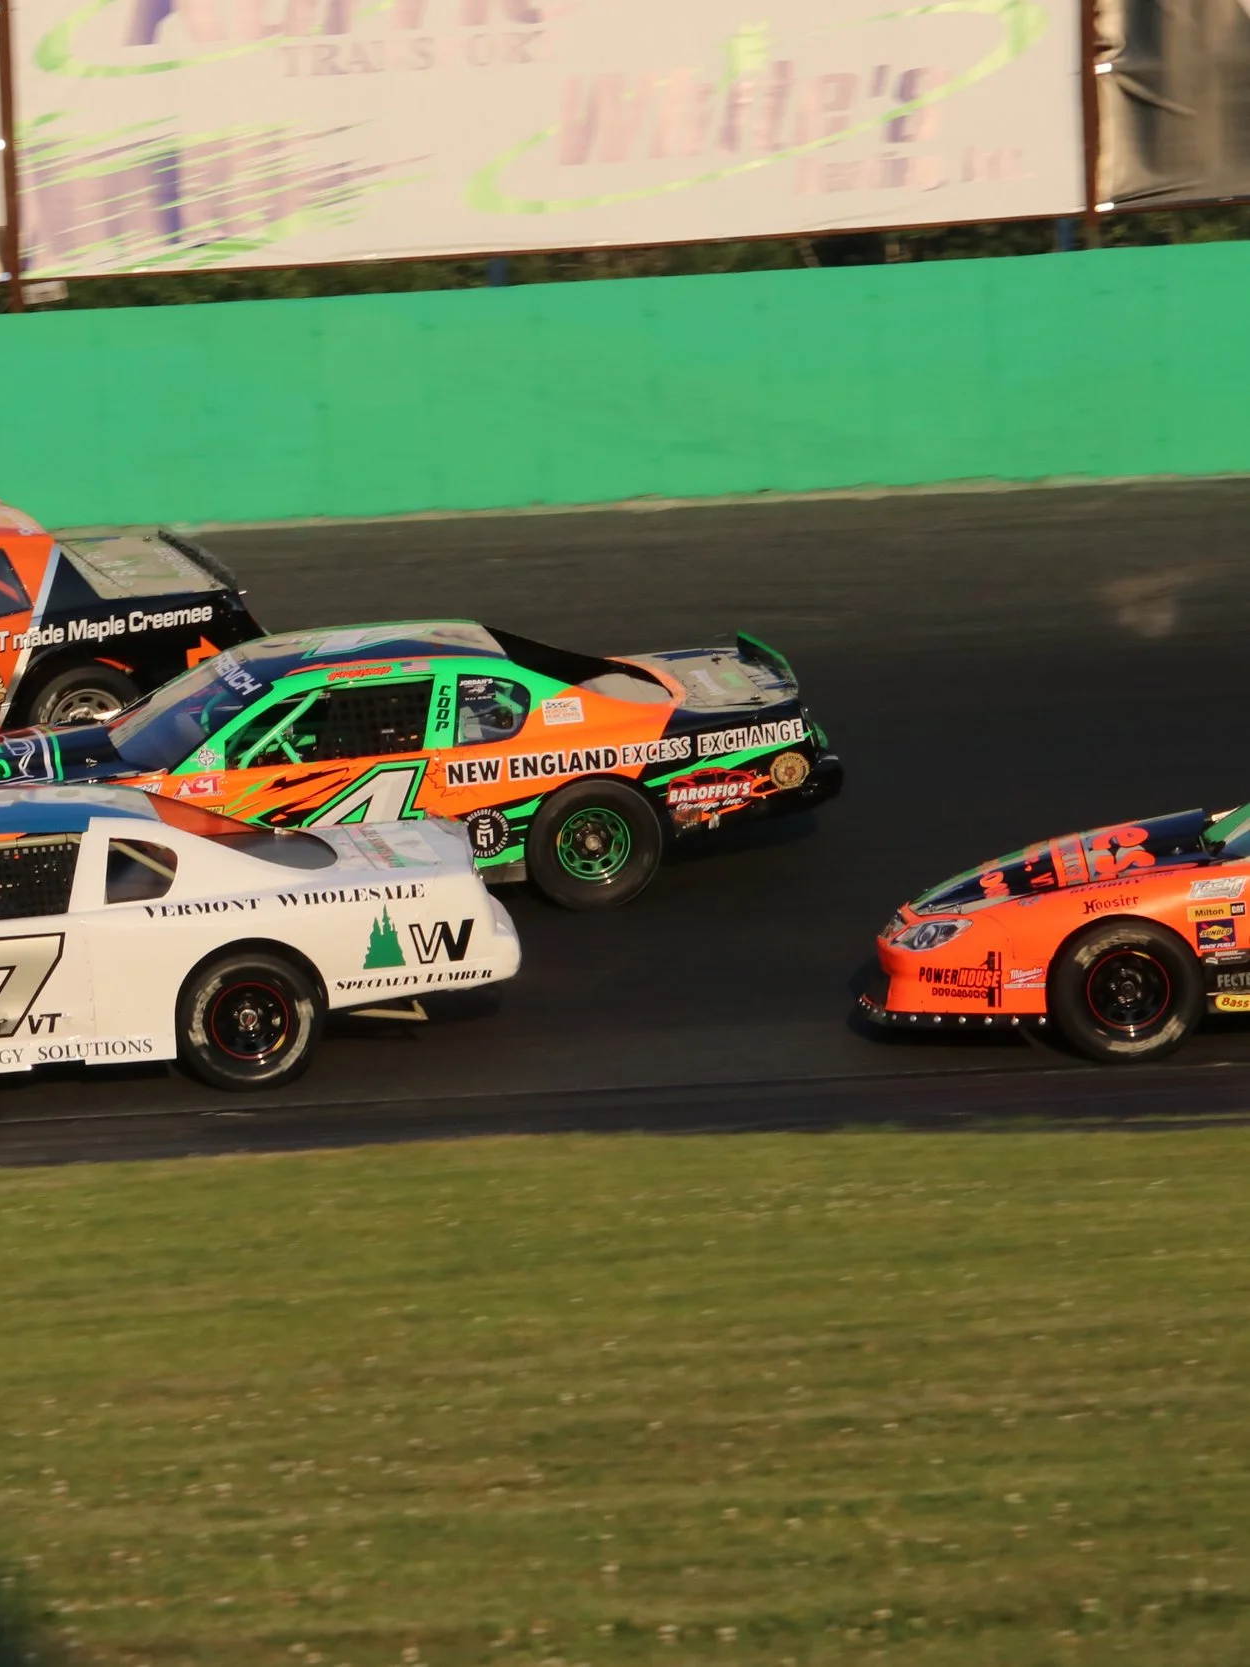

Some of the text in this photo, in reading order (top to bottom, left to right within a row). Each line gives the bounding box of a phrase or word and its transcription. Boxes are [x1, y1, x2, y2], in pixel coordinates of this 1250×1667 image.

[12, 623, 65, 650] made
[68, 614, 126, 642] Maple
[129, 605, 213, 632] Creemee
[448, 718, 803, 785] NEW ENGLAND EXCESS EXCHANGE
[669, 782, 751, 803] BAROFFIO'S
[144, 883, 426, 919] VERMONT WHOLESALE
[1082, 894, 1140, 915] Hoosier
[1194, 904, 1245, 917] Milton CAT
[408, 918, 475, 964] W
[1200, 927, 1233, 938] SUNOCO
[335, 969, 493, 991] SPECIALTY LUMBER
[27, 1013, 62, 1035] VT
[37, 1038, 153, 1062] SOLUTIONS
